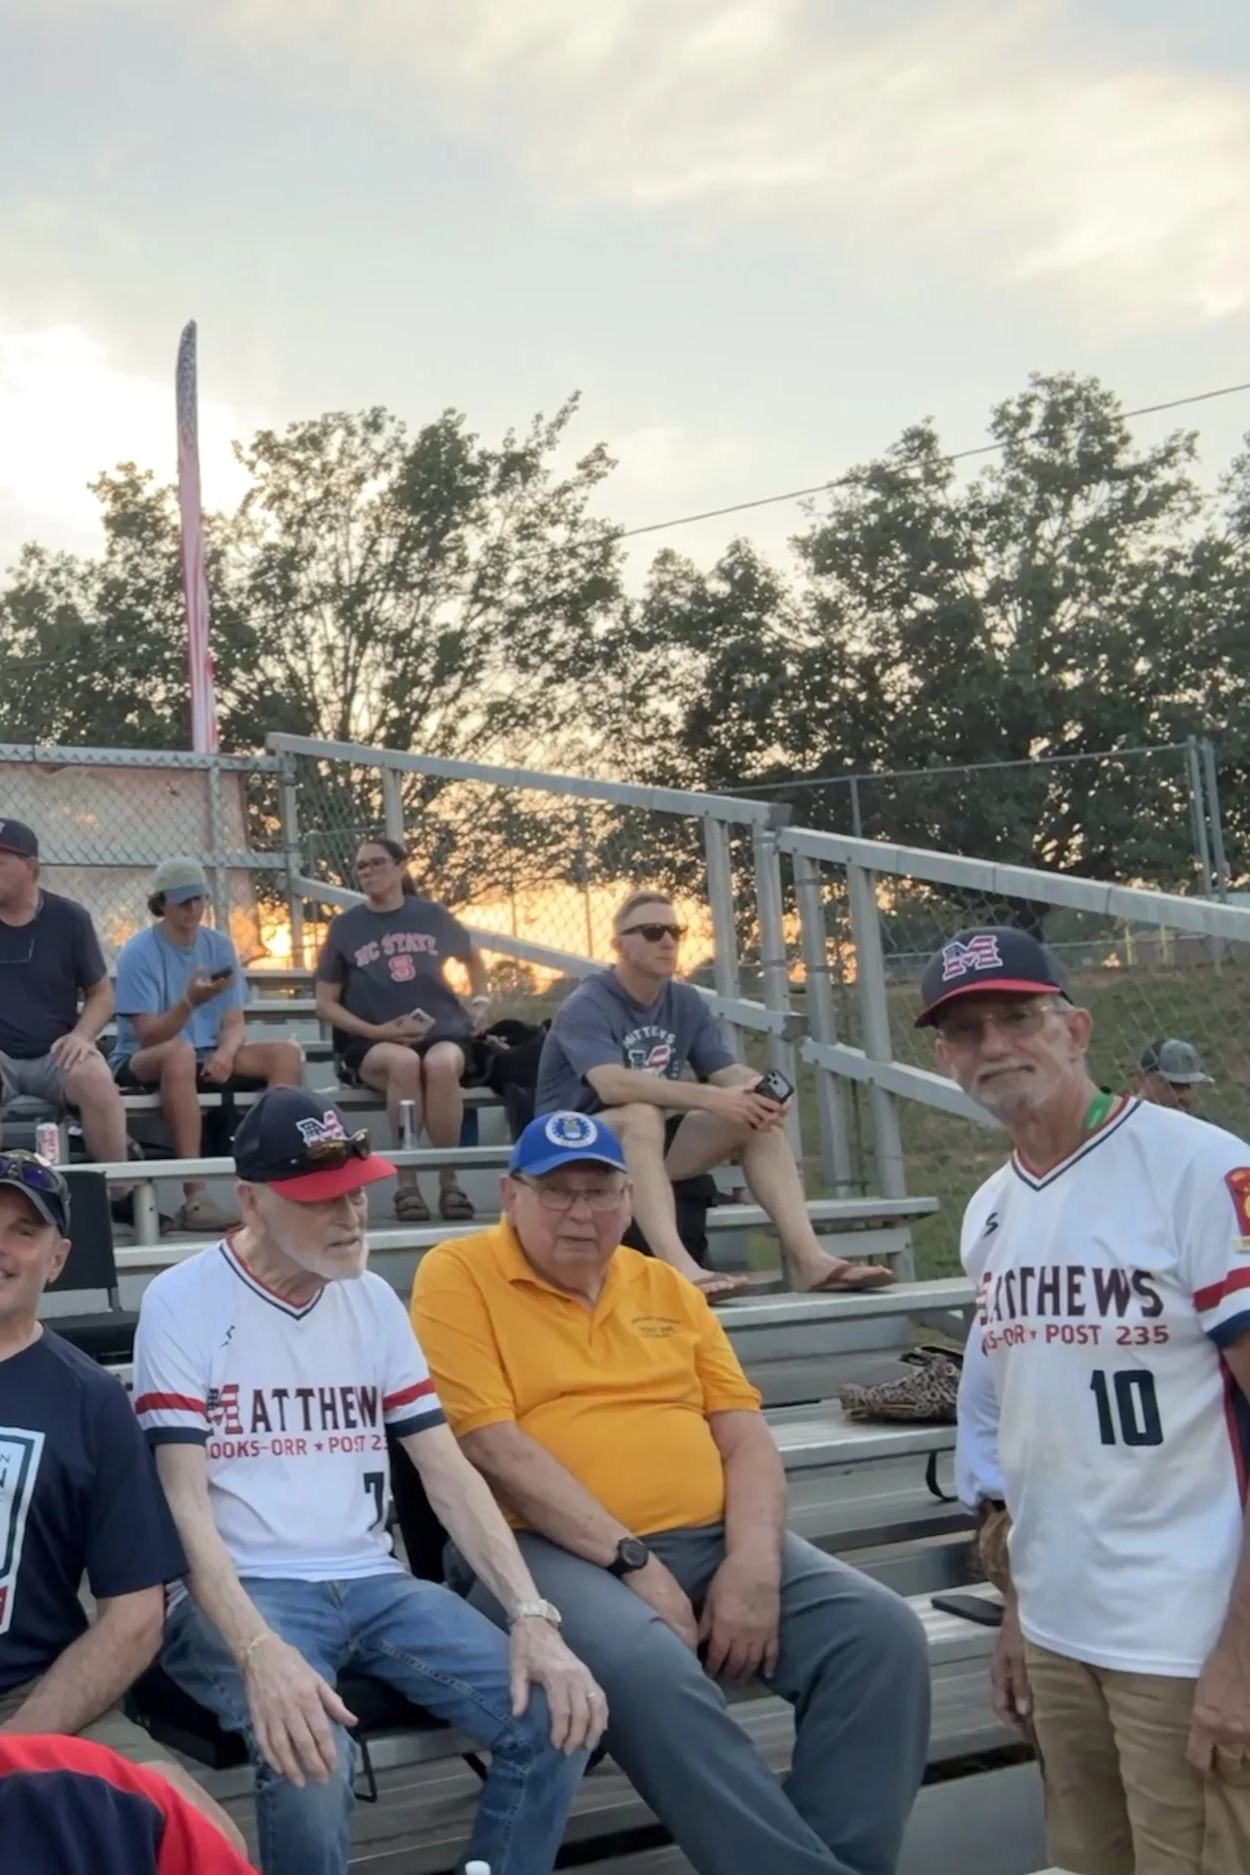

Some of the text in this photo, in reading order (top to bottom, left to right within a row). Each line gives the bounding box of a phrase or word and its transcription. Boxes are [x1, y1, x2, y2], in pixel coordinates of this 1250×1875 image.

[382, 933, 439, 956] STATE
[1046, 1324, 1101, 1345] POST
[1116, 1325, 1170, 1346] 235
[1090, 1369, 1164, 1446] 10
[208, 1438, 308, 1460] OOKS-ORR
[363, 1471, 385, 1532] 7
